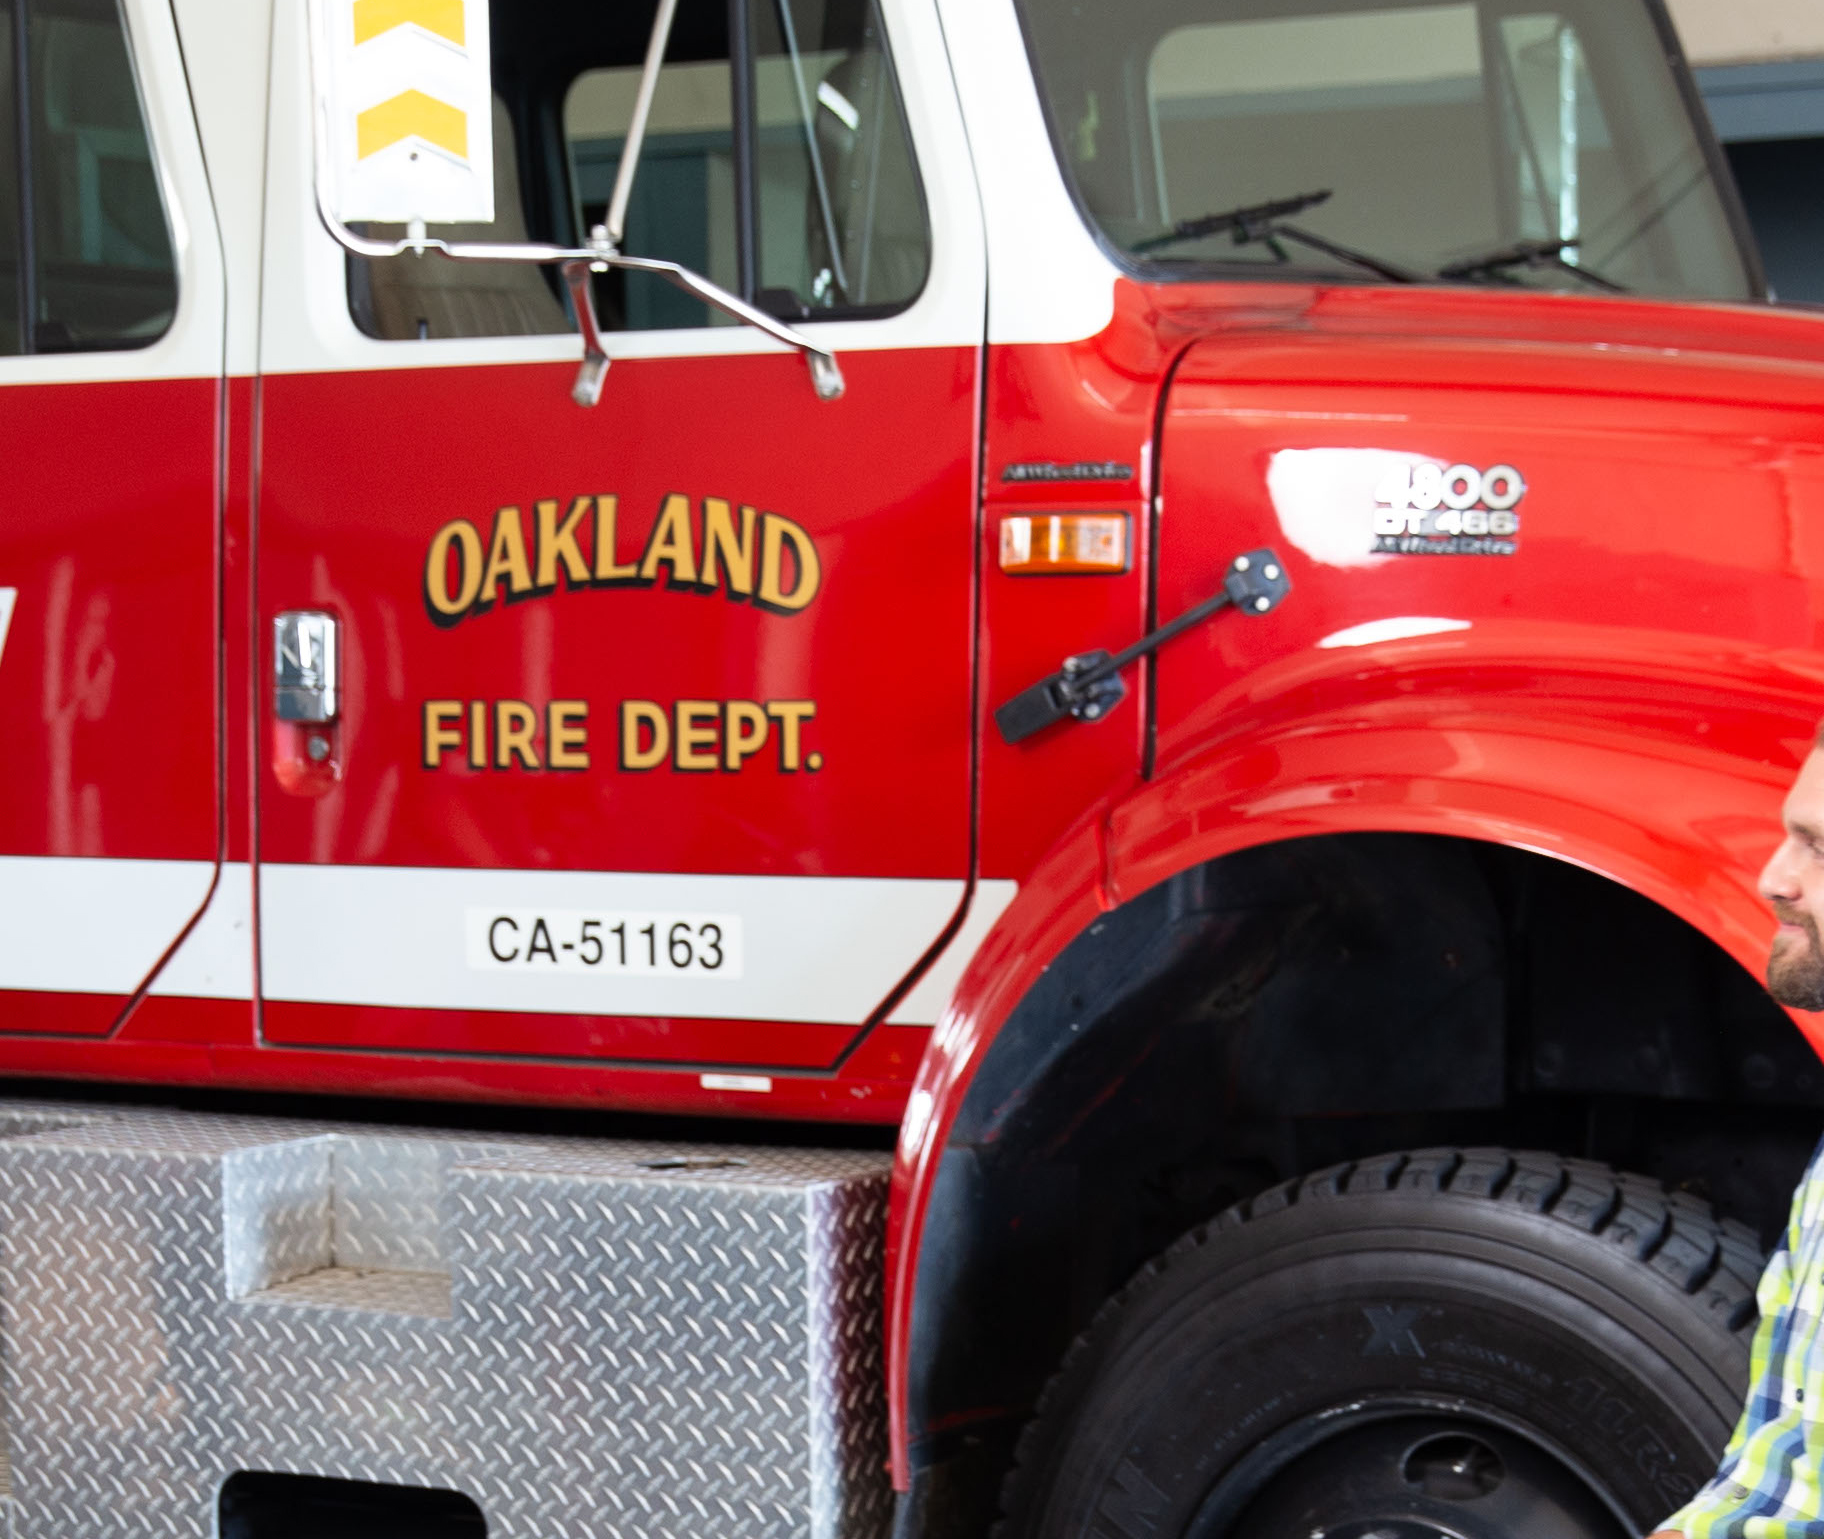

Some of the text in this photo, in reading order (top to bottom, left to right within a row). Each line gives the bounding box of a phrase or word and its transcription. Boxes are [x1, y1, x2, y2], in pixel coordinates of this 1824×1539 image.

[1374, 463, 1524, 511] 4800
[423, 493, 822, 628] OAKLAND
[422, 700, 824, 772] FIRE DEPT.
[488, 916, 725, 970] CA-51163
